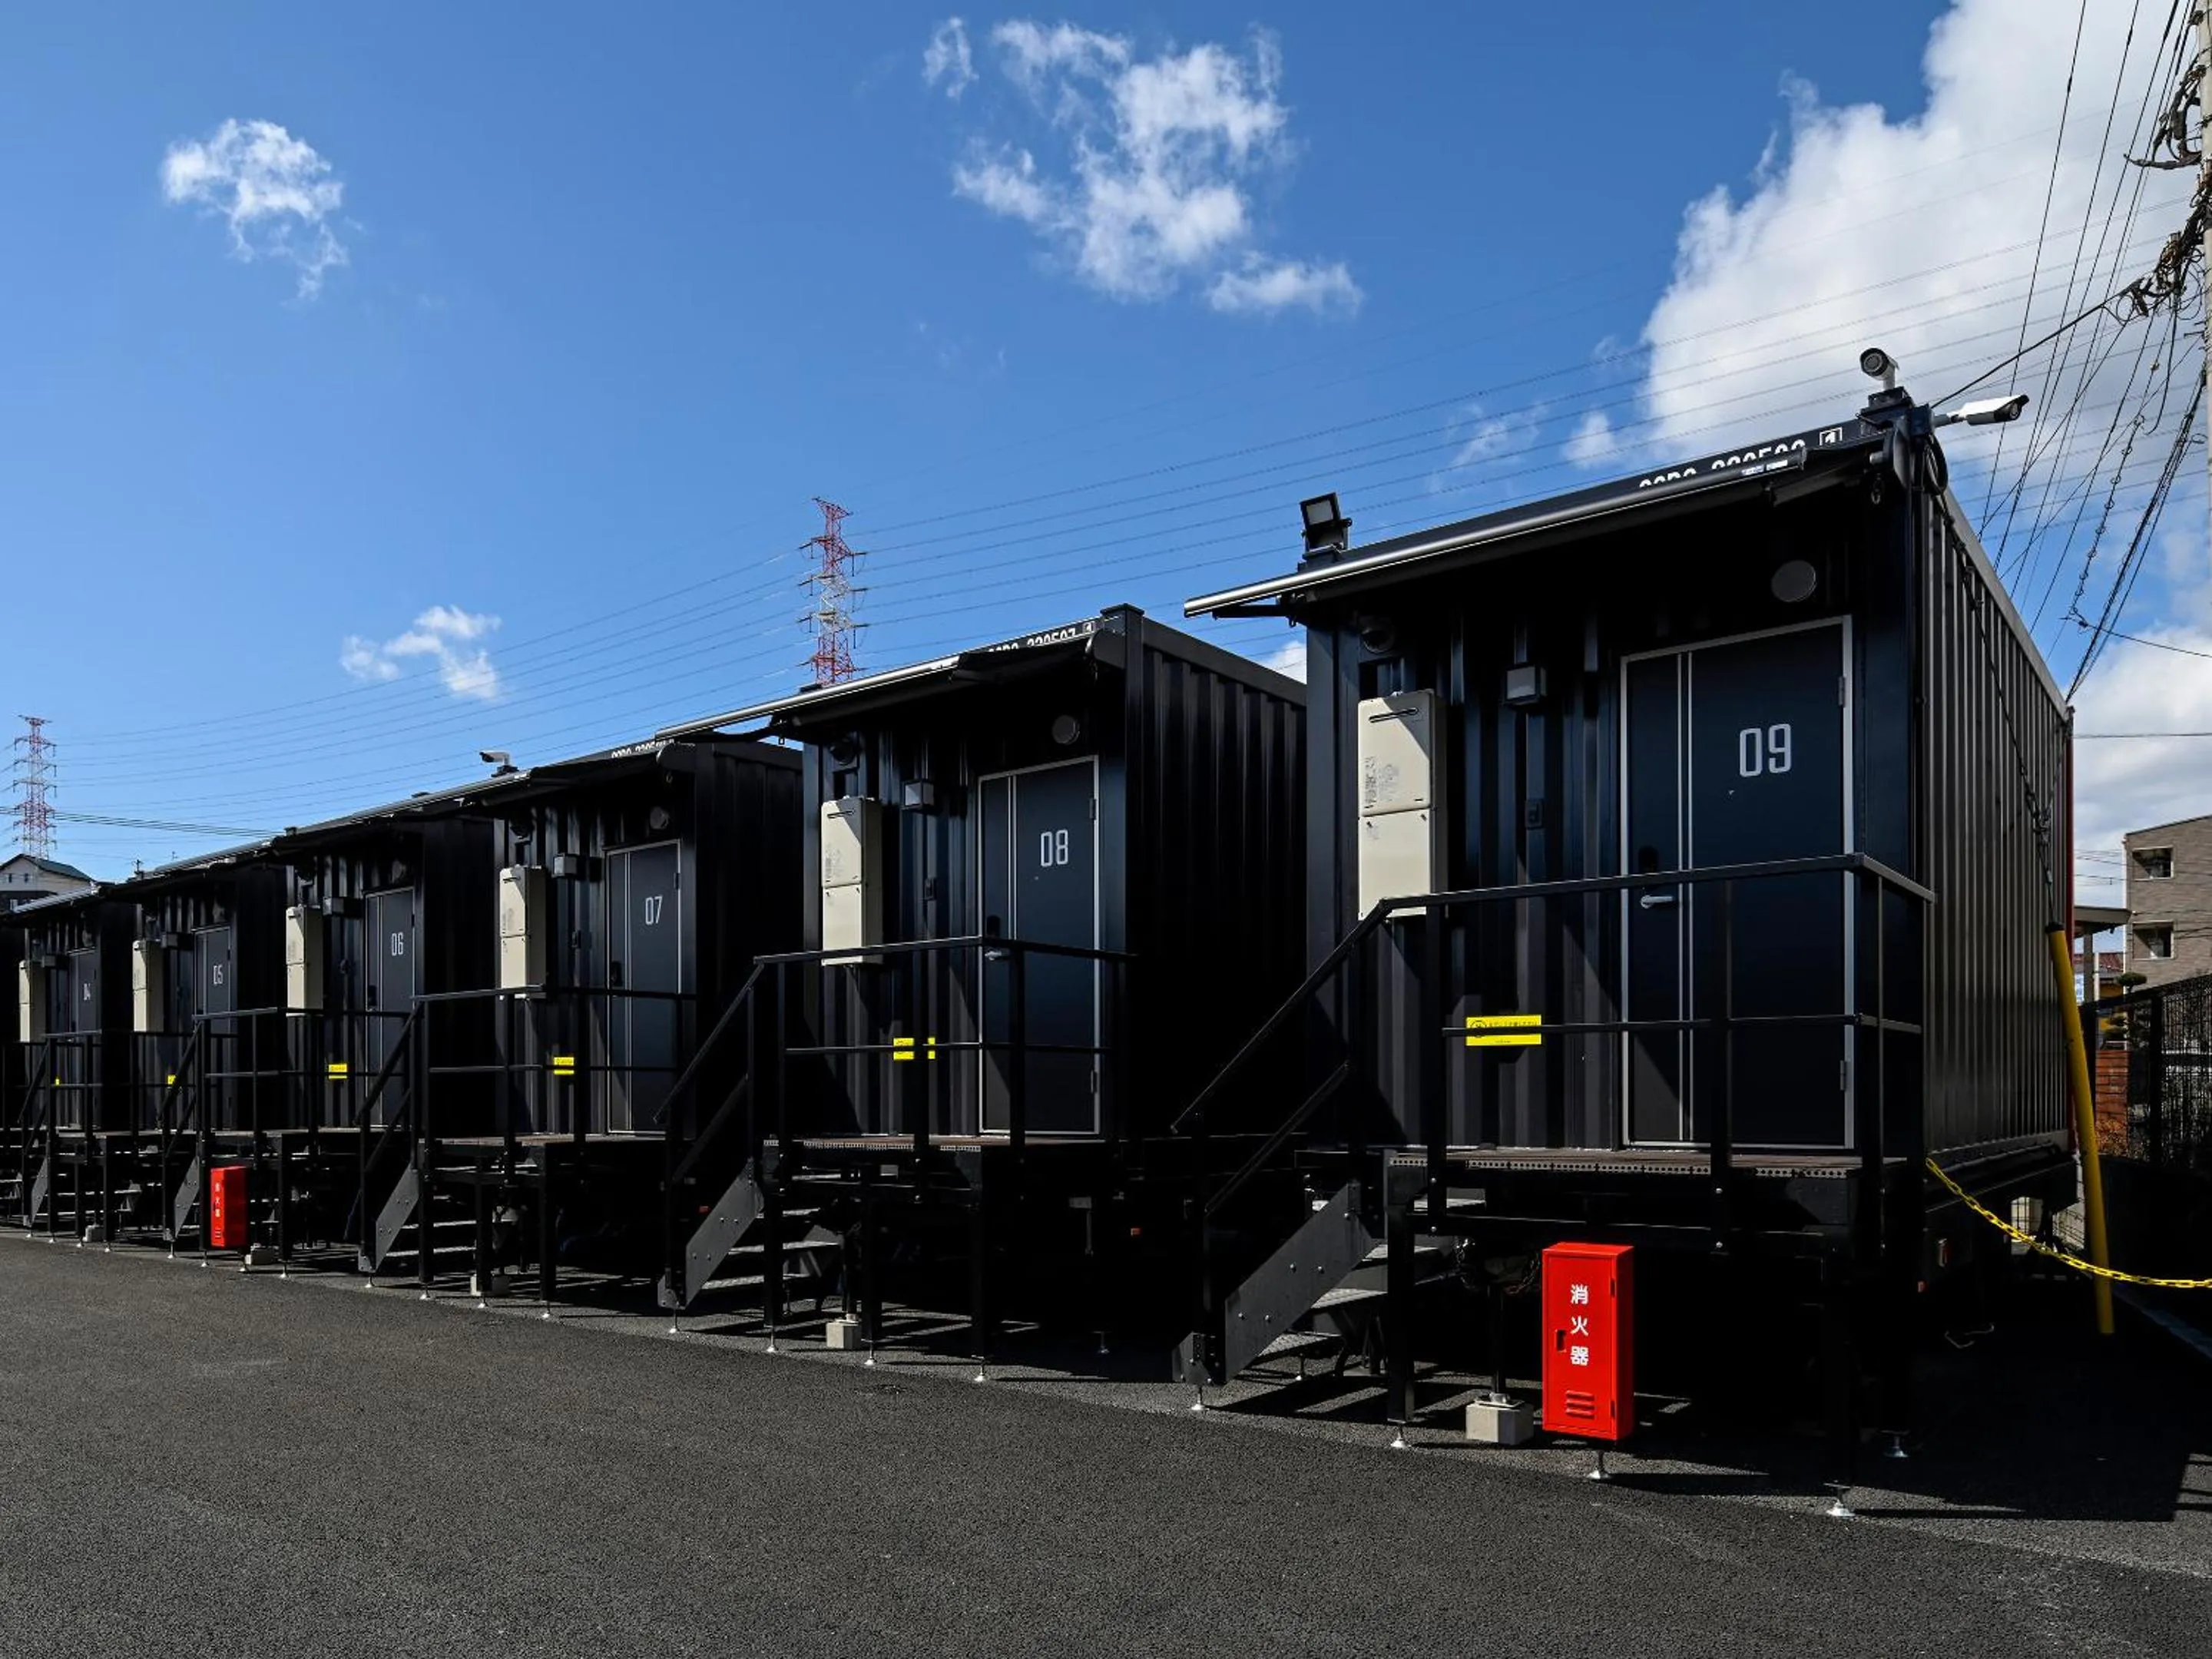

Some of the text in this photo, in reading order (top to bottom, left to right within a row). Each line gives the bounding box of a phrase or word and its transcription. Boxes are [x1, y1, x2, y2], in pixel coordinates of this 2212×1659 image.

[1740, 724, 1791, 777] 09
[1040, 829, 1068, 867] 08
[645, 895, 663, 926] 07
[391, 932, 403, 956] 06
[1570, 1283, 1589, 1366] 消火器
